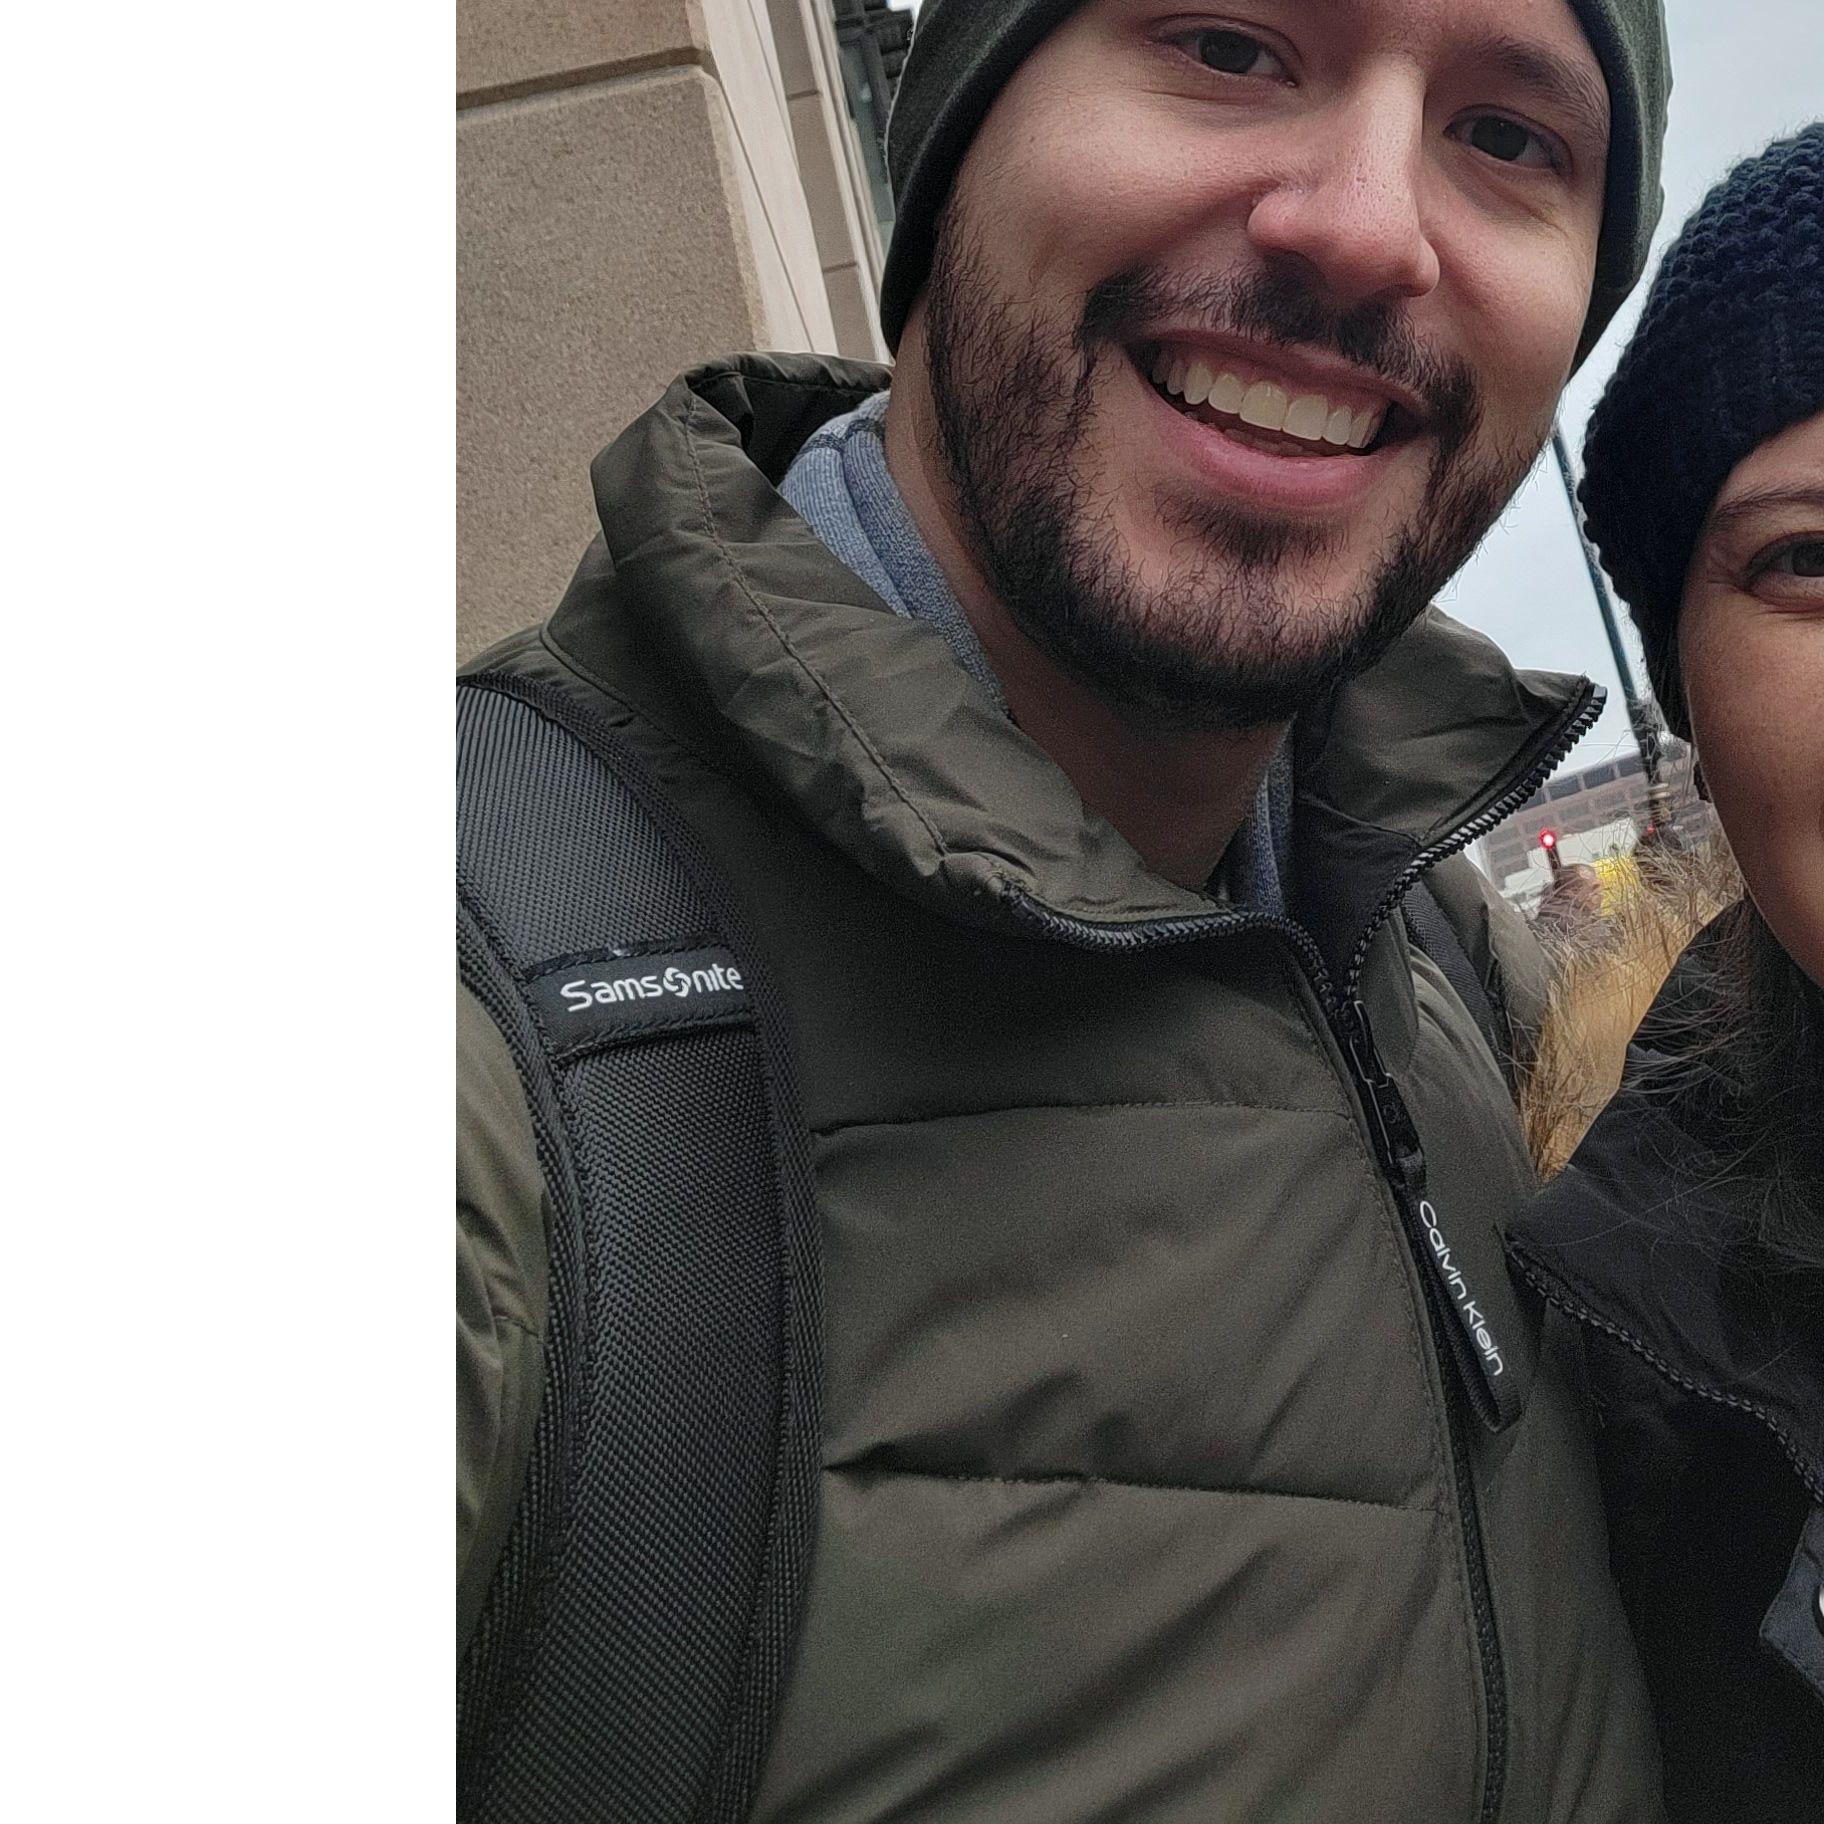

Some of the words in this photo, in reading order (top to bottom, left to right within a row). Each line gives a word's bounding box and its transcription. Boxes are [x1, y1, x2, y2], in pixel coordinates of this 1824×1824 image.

[560, 962, 744, 1012] Samsonite
[1419, 1200, 1468, 1300] Calvin
[1462, 1300, 1504, 1376] Klein
